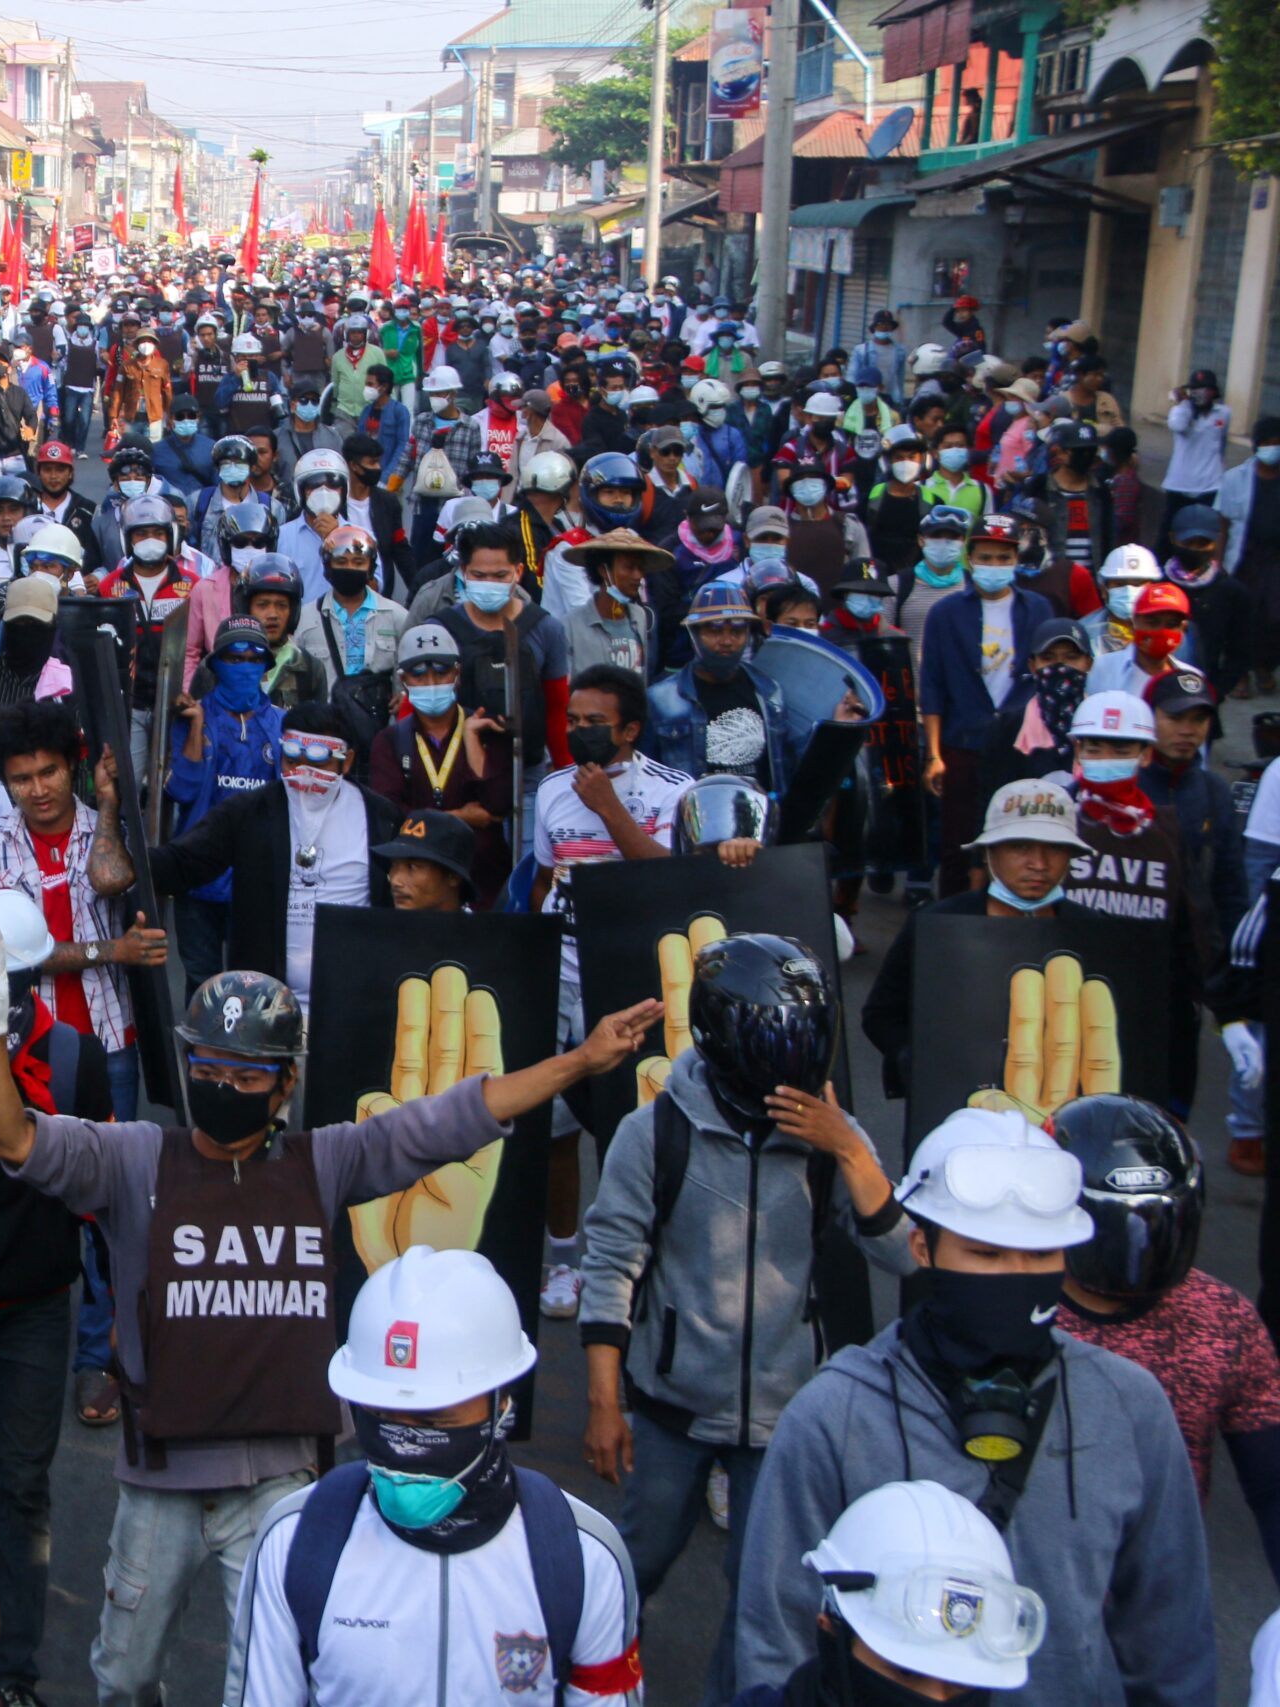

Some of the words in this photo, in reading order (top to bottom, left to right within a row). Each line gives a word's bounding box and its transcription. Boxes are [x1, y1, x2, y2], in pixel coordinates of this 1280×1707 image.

[217, 774, 266, 790] YOKOHA
[1070, 854, 1167, 888] SAVE
[1066, 888, 1167, 918] MYANMAR
[1114, 1171, 1163, 1185] INDEX
[173, 1224, 324, 1266] SAVE
[166, 1280, 327, 1318] MYANMAR
